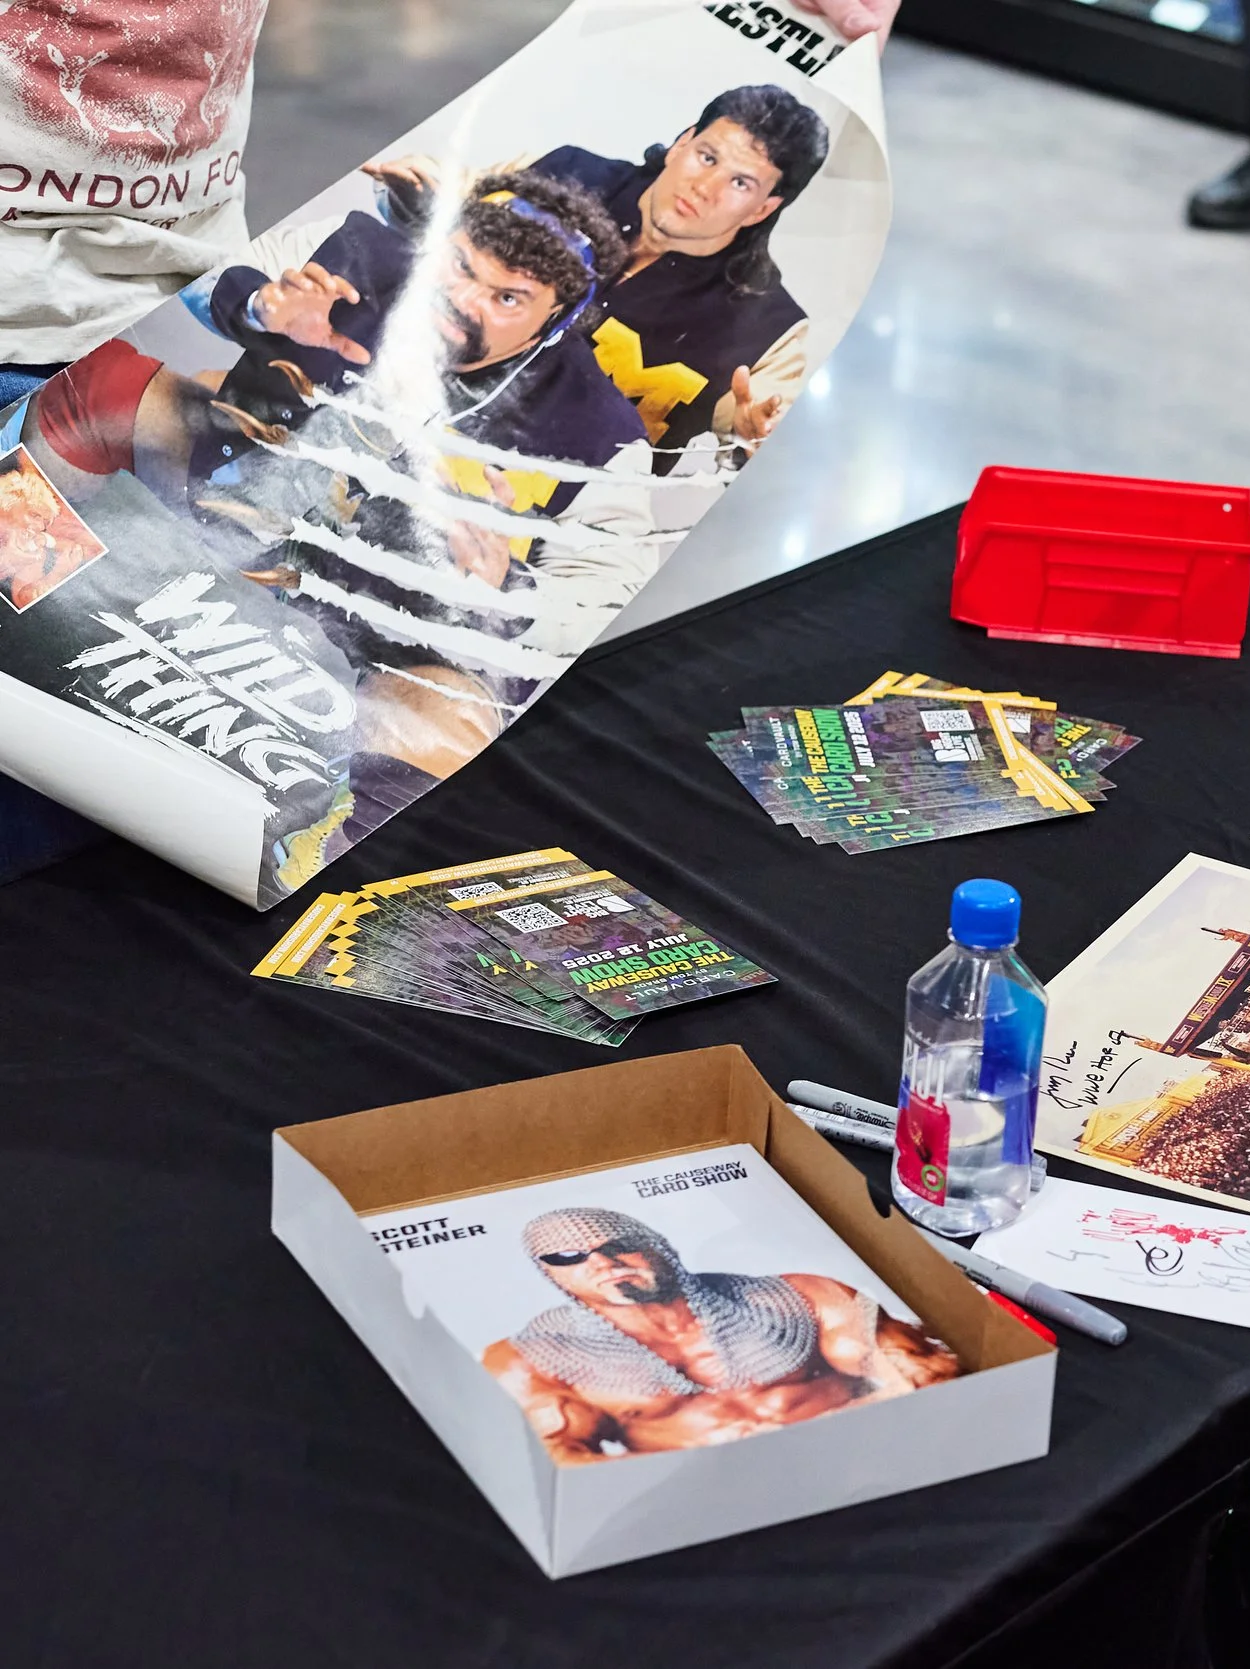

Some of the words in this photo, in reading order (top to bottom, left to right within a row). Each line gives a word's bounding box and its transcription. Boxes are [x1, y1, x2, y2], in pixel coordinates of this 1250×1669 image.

[704, 0, 846, 77] ESTL
[135, 571, 357, 740] WILD
[58, 611, 340, 792] THING
[794, 709, 824, 756] CAUSEWAY
[812, 708, 846, 742] SHOW
[851, 733, 870, 747] 12
[769, 717, 792, 768] CARDVAULT
[822, 742, 856, 774] CARD
[854, 745, 876, 768] JULY
[808, 755, 829, 774] THE
[616, 943, 644, 956] 12
[647, 940, 721, 966] CARD
[648, 933, 689, 950] JULY
[561, 950, 616, 970] 2025
[569, 956, 650, 986] SHOW
[691, 951, 735, 967] THE
[587, 960, 692, 994] CAUSEWAY
[624, 969, 736, 1002] CARDVAULT
[631, 1177, 661, 1189] THE
[663, 1161, 742, 1183] CAUSEWAY
[637, 1179, 691, 1199] CARD
[695, 1167, 748, 1188] SHOW
